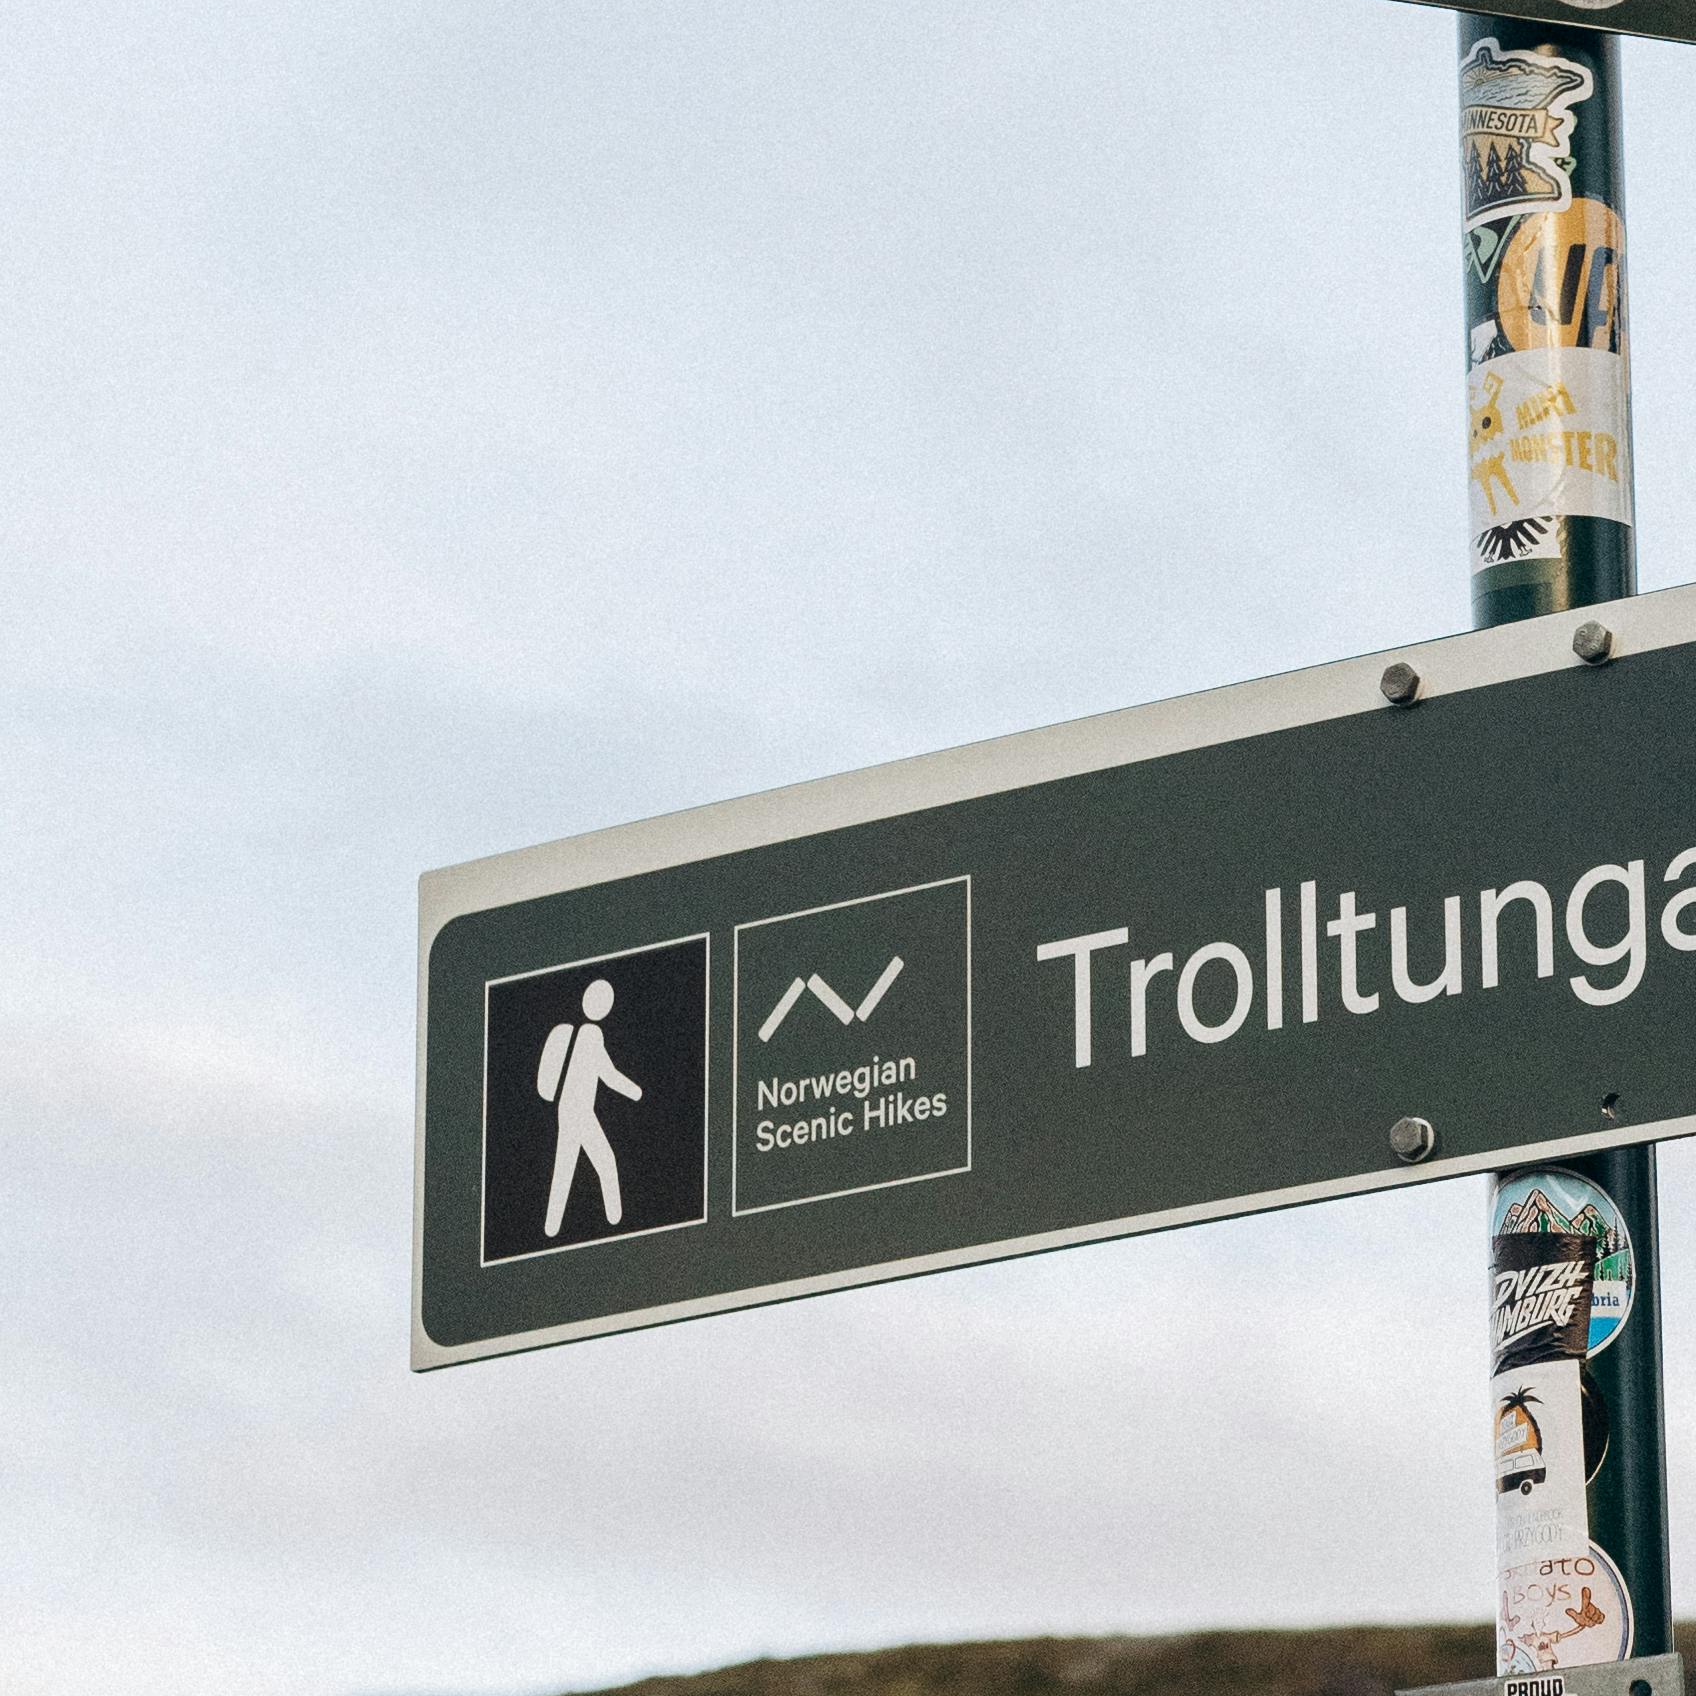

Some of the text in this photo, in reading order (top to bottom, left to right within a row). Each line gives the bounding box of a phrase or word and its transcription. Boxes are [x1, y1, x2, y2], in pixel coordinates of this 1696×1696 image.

[758, 1055, 916, 1110] Norwegian
[756, 1092, 947, 1152] Scenic Hikes
[1592, 1293, 1620, 1307] bria
